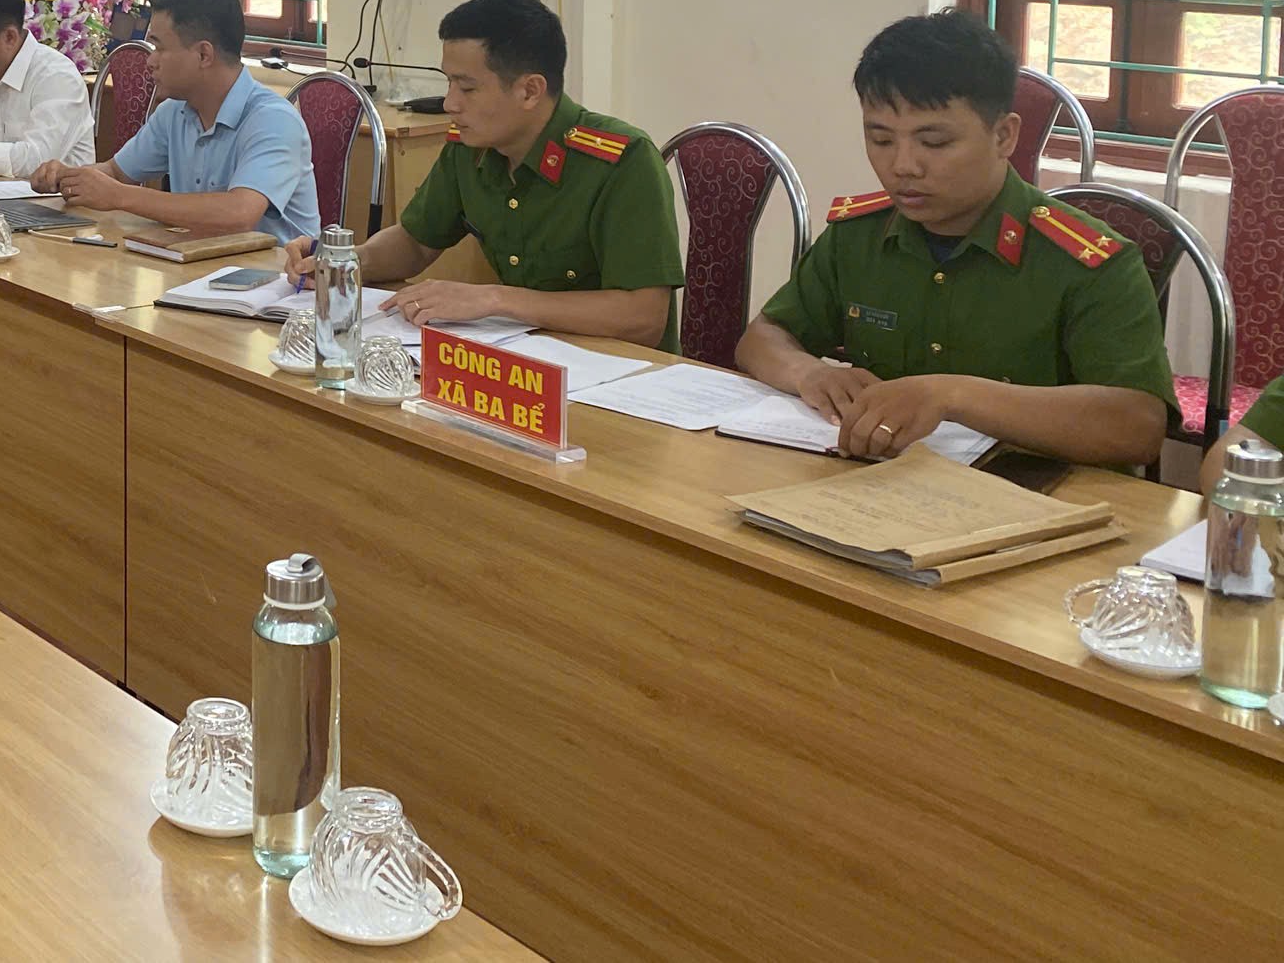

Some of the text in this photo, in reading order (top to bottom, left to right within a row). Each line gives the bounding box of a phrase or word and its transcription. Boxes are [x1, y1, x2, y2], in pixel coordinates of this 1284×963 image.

[438, 342, 544, 395] CÔNG AN
[437, 378, 545, 434] XÃ BA BỂ
